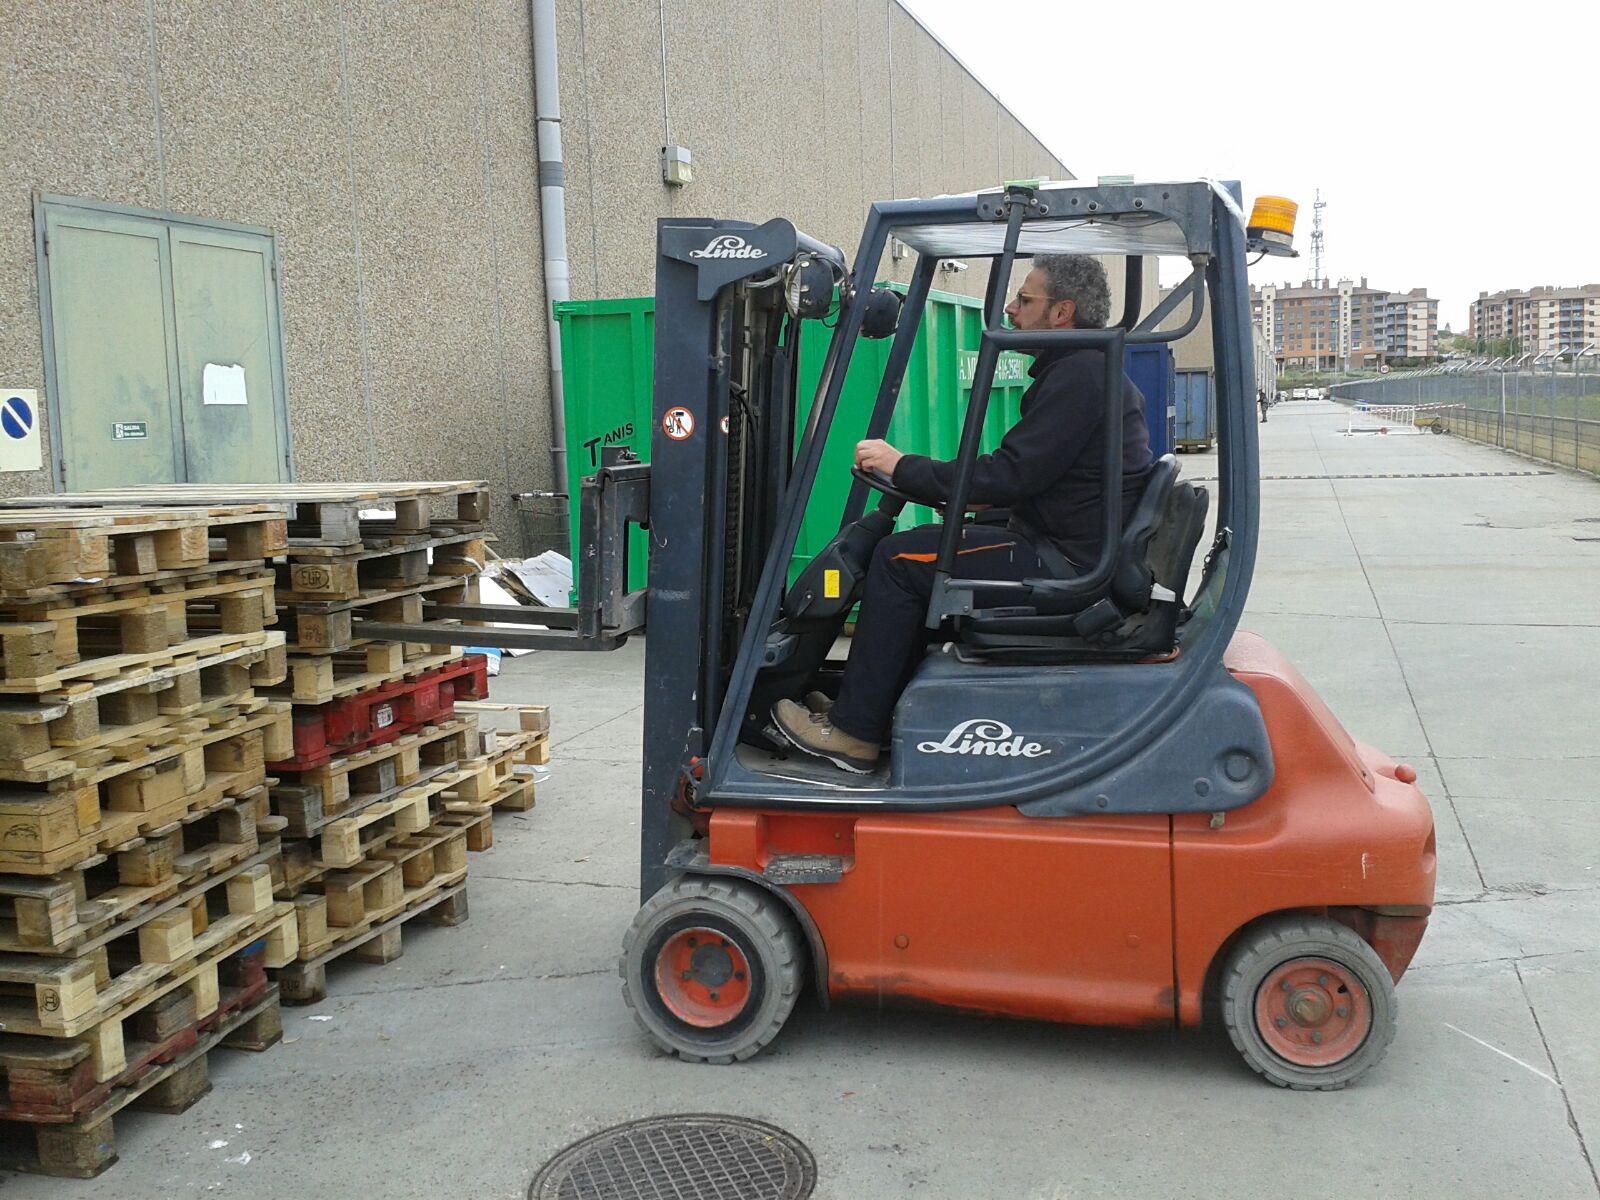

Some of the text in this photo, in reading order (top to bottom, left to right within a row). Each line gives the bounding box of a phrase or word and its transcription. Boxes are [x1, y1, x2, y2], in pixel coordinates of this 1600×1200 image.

[689, 235, 768, 259] Linde
[583, 422, 634, 467] TANIS
[916, 718, 1052, 758] Linde
